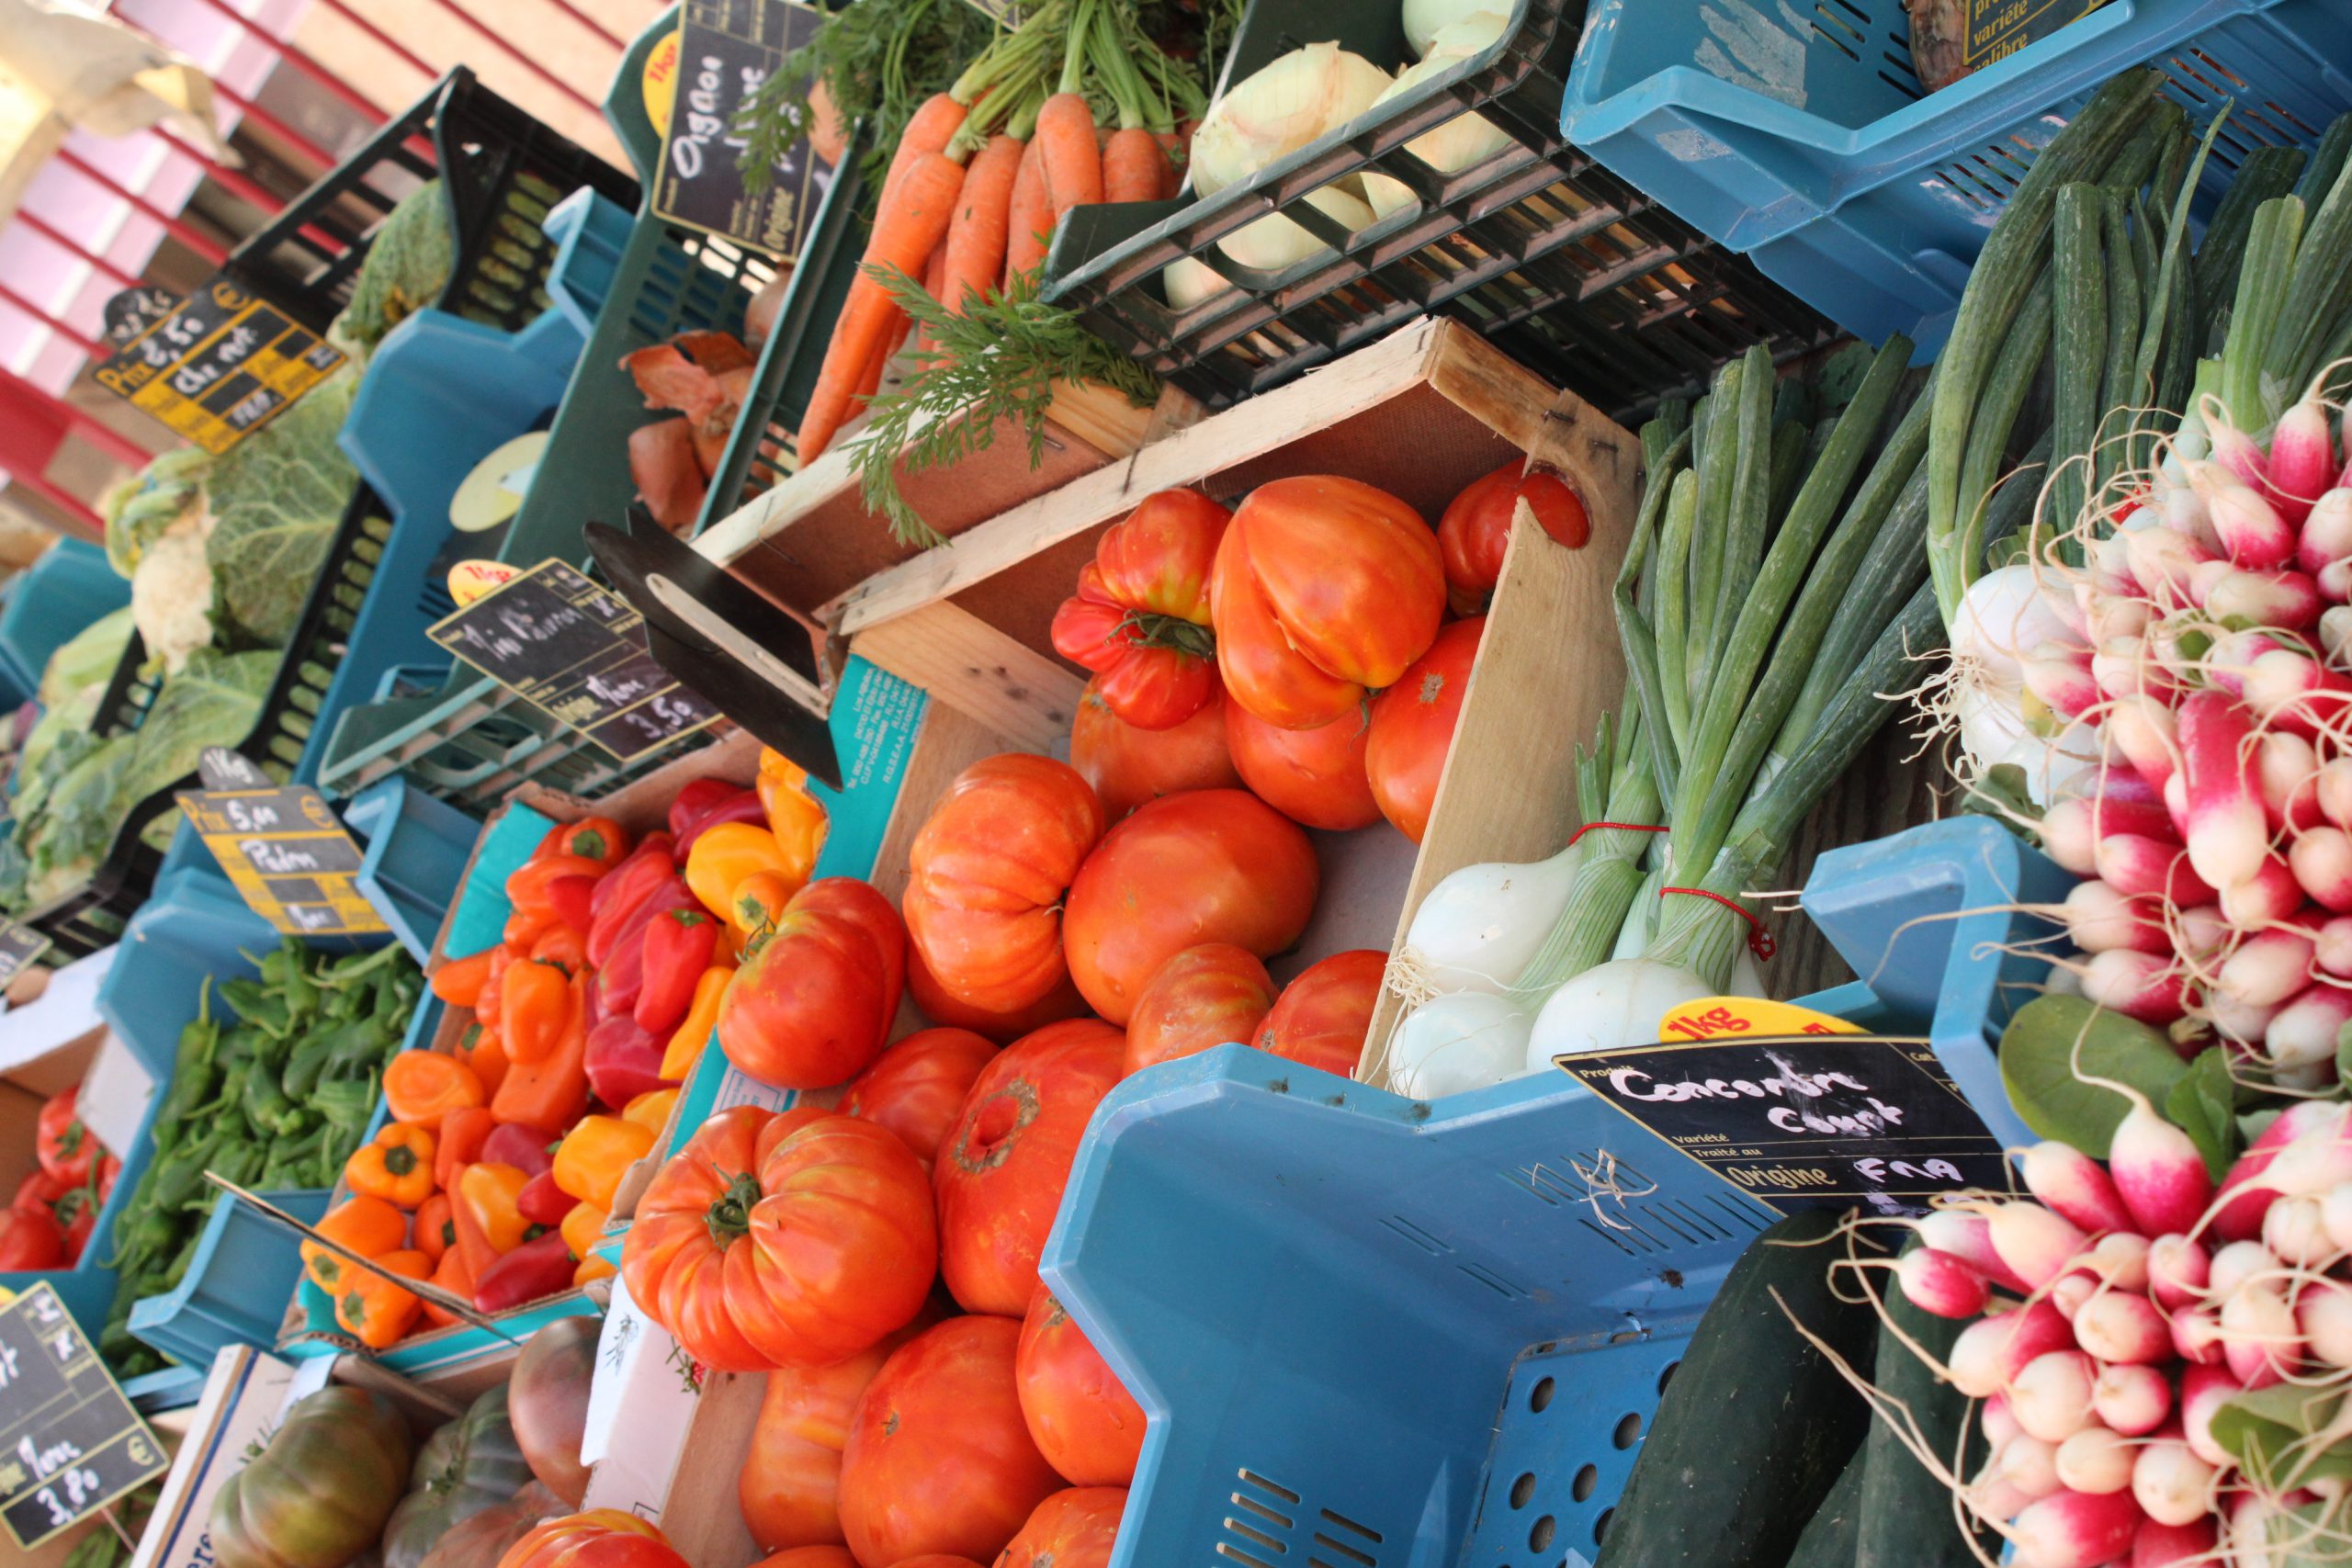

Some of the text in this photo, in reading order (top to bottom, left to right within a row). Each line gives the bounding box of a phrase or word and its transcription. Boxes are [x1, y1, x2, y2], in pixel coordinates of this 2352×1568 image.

[1668, 1007, 1750, 1040] 1kg
[1671, 1133, 1730, 1145] Variété
[1692, 1147, 1763, 1157] Traité au
[1726, 1165, 1838, 1190] Origine
